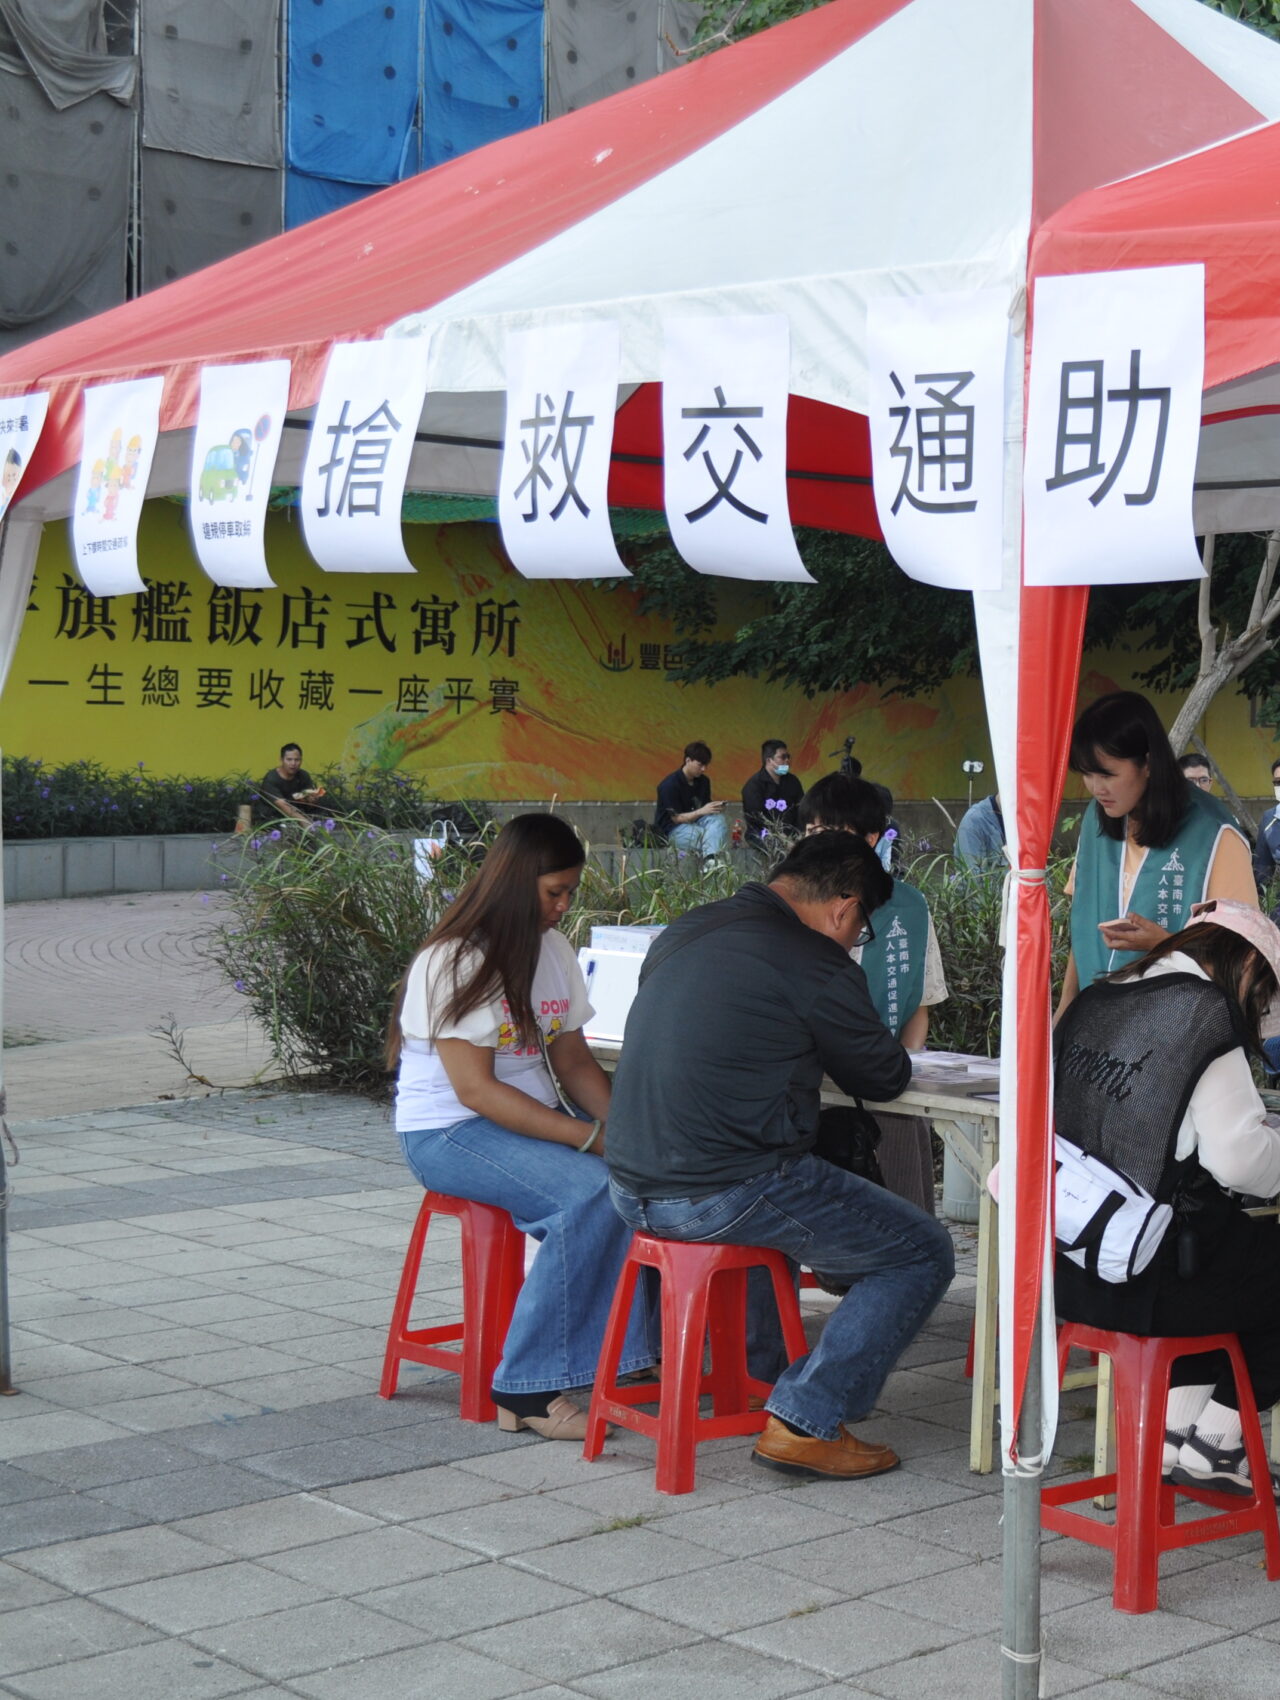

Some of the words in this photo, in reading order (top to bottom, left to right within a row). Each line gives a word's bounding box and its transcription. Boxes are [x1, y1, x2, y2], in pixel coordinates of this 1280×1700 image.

[28, 662, 521, 716] 一生總要收藏一座平實
